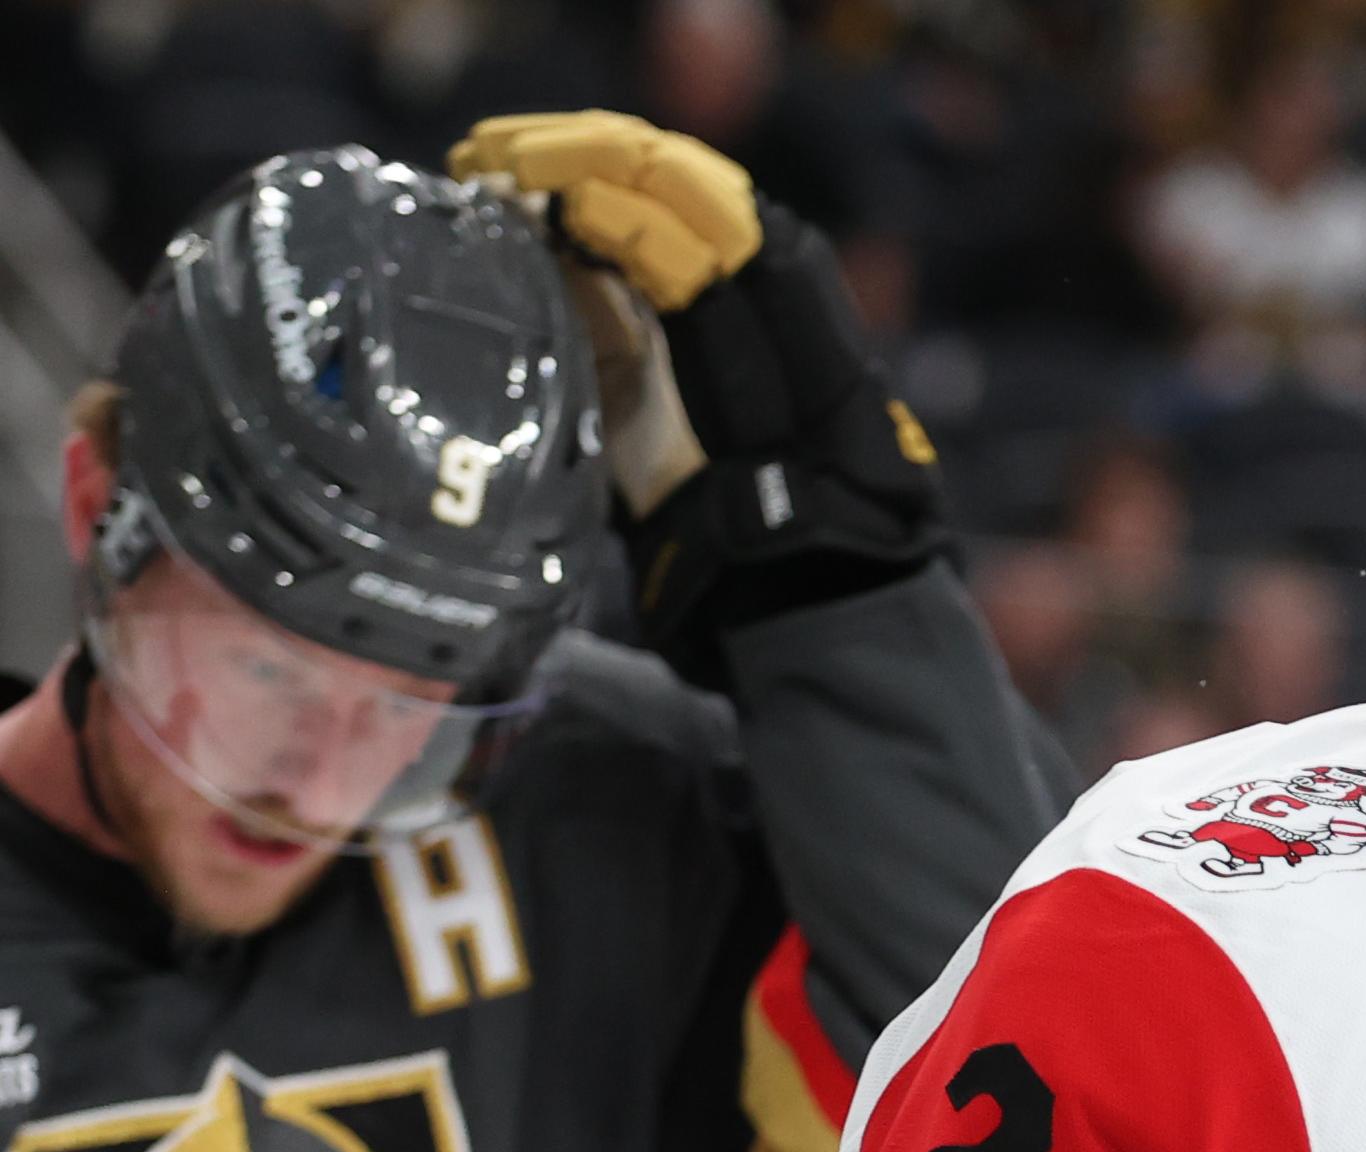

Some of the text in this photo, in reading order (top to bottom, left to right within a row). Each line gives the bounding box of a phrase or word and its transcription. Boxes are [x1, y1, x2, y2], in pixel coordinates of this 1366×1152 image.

[431, 434, 494, 528] 9
[1250, 794, 1309, 818] C
[371, 812, 533, 1018] A
